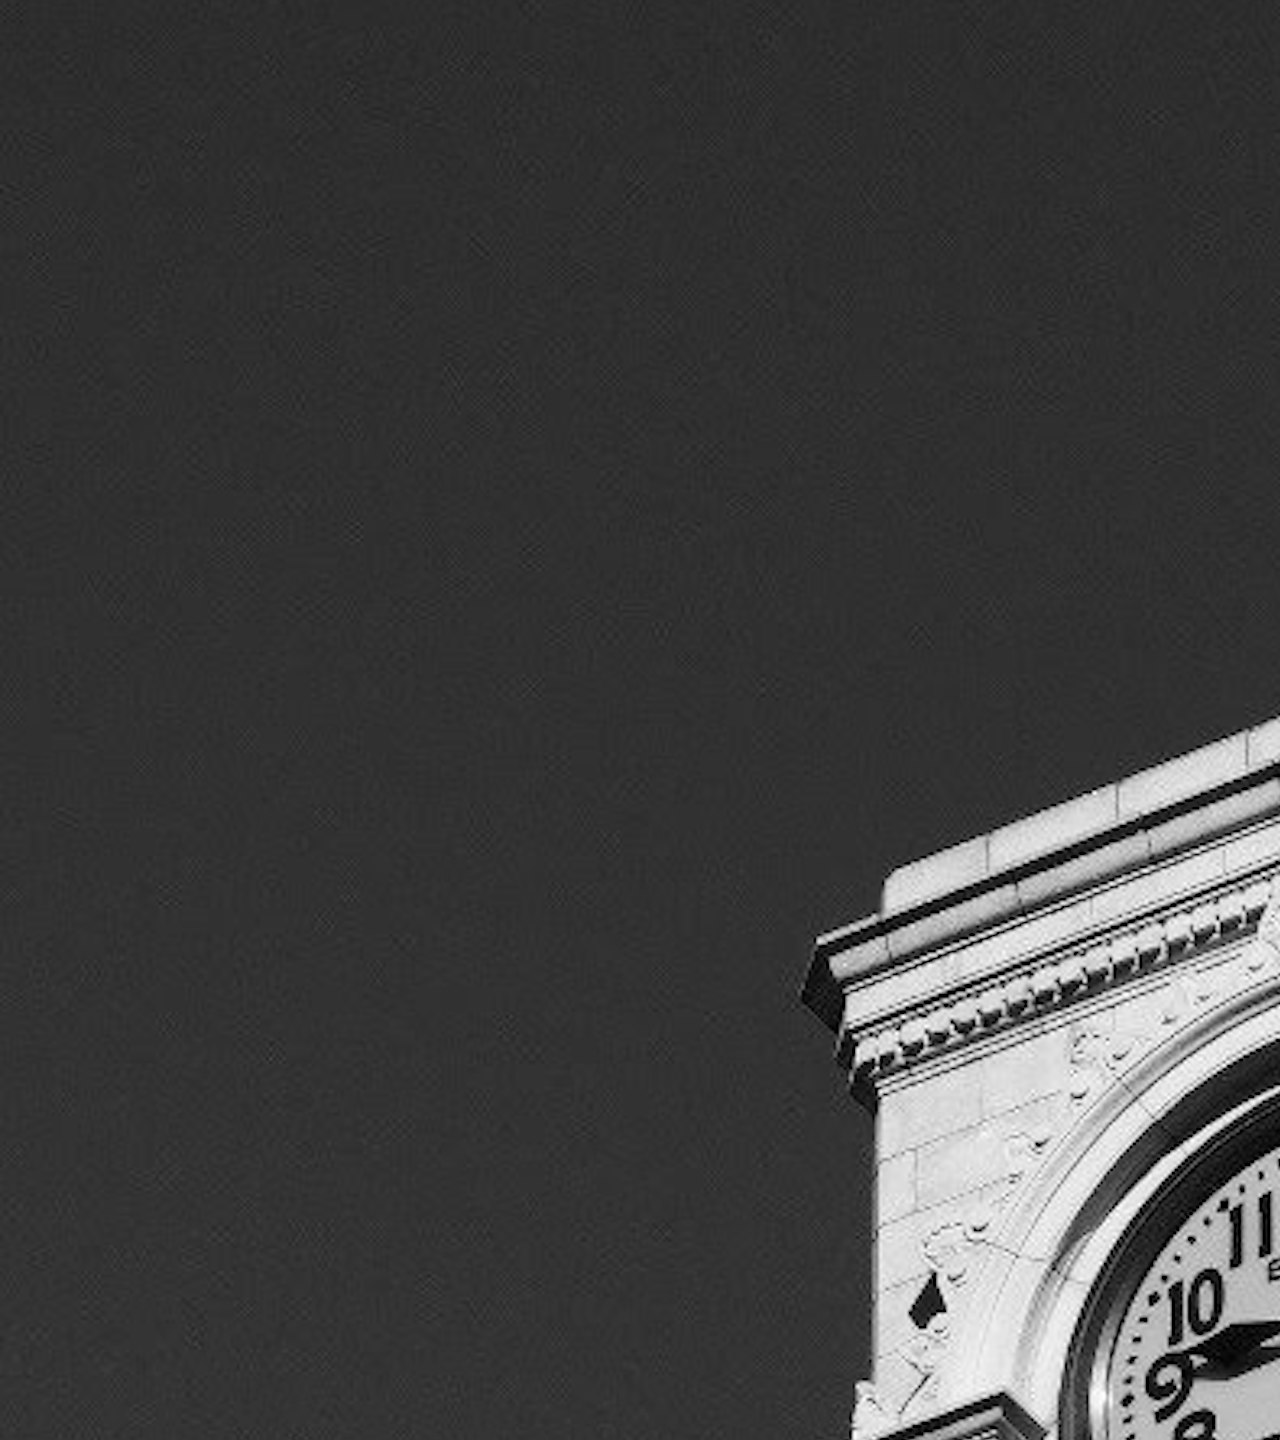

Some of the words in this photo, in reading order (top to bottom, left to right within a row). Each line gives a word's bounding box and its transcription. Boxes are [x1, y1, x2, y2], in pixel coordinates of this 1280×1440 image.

[1230, 1191, 1271, 1268] 11
[1168, 1268, 1223, 1346] 10
[1145, 1353, 1192, 1423] 9
